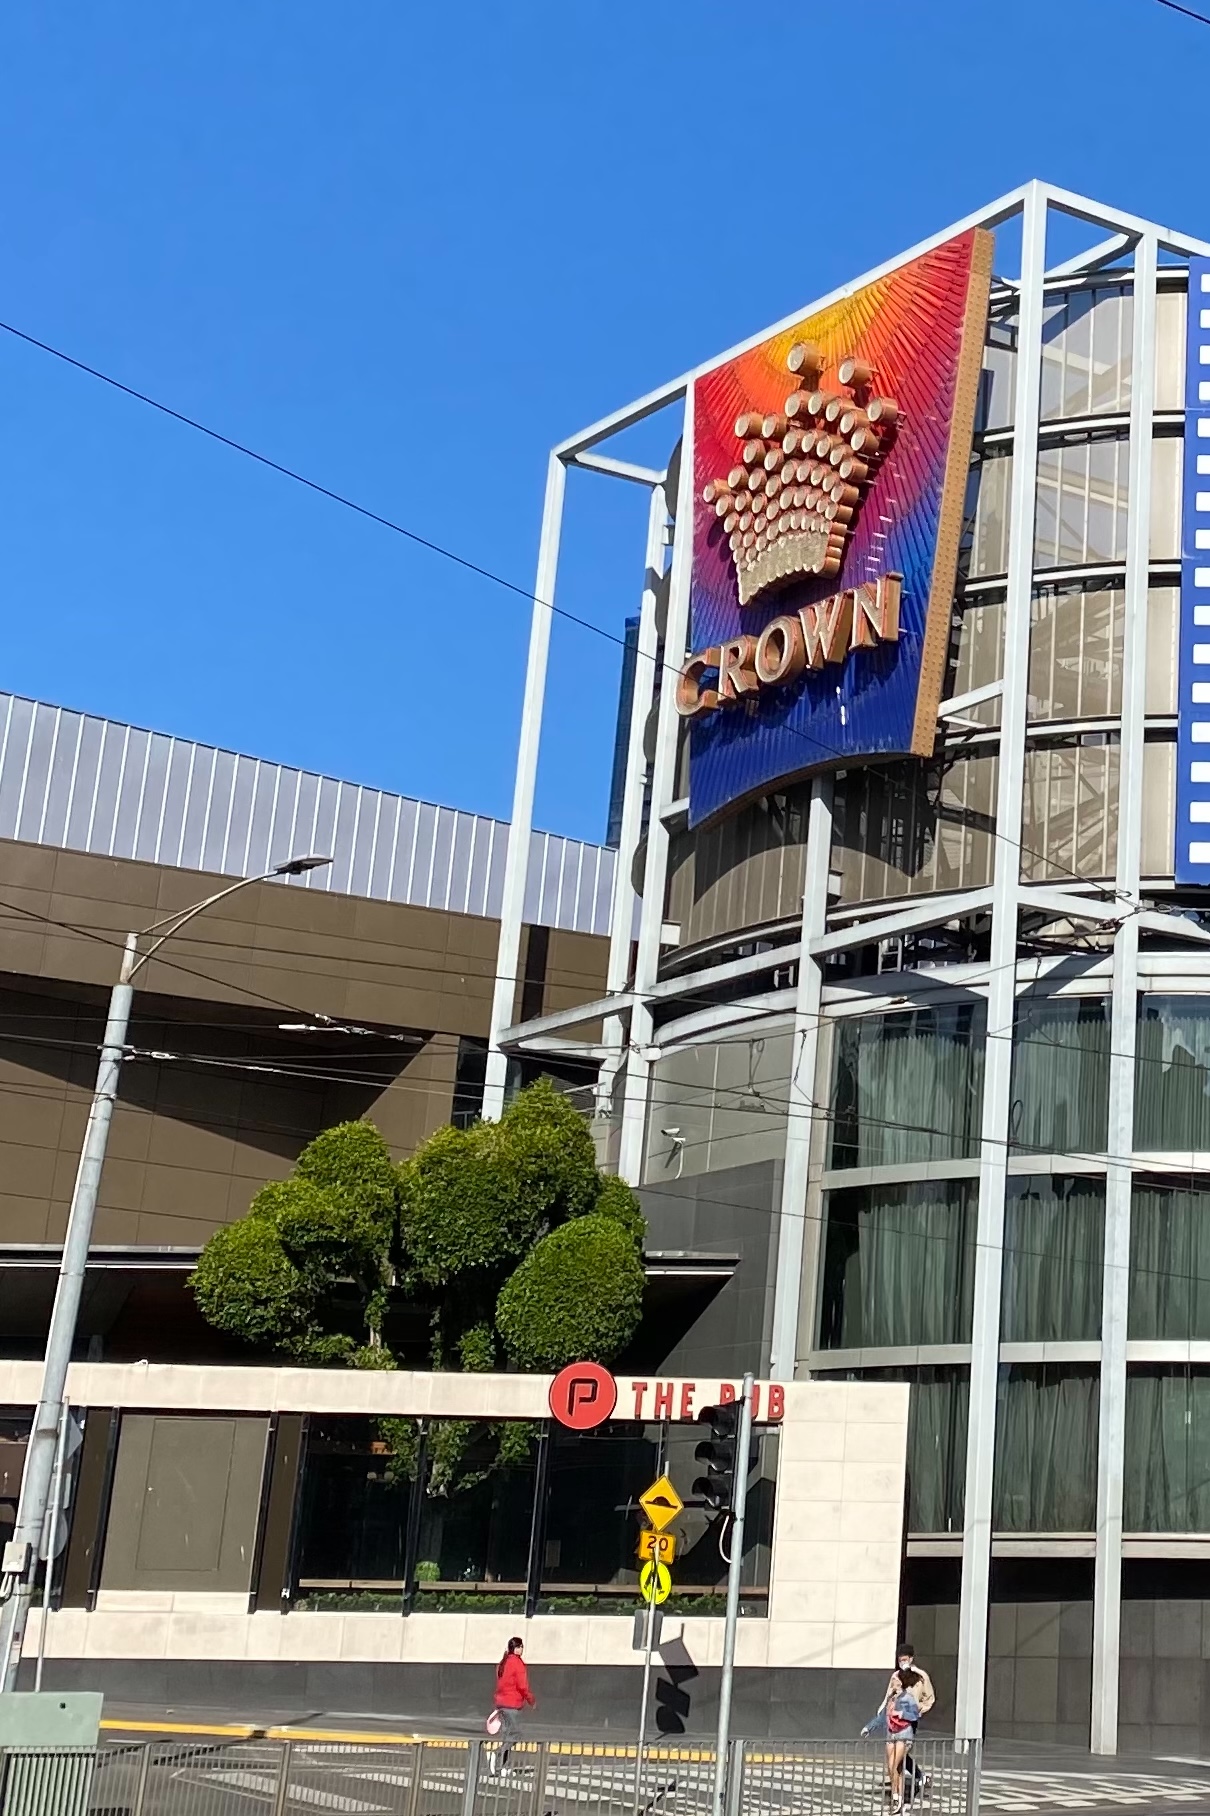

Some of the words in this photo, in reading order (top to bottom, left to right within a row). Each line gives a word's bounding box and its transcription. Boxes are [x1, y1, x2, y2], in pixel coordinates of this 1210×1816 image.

[674, 572, 904, 716] CROWN
[632, 1381, 696, 1420] THE
[647, 1535, 669, 1552] 20
